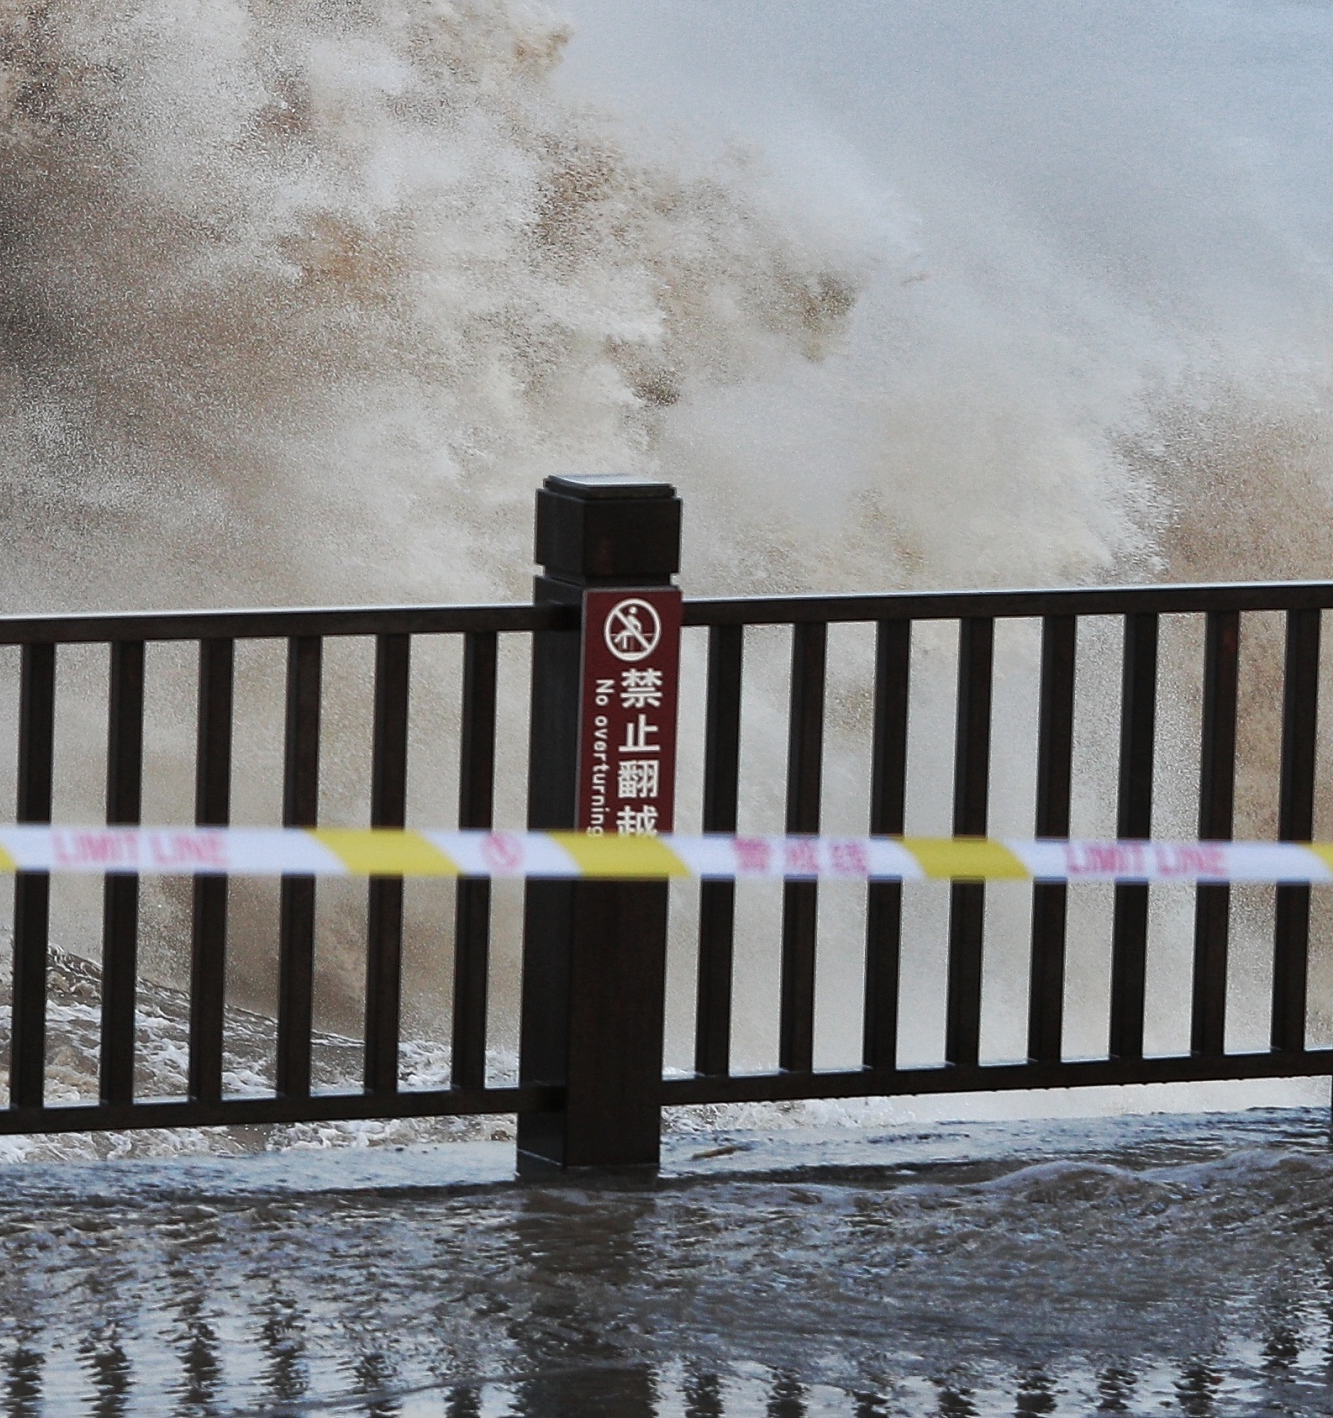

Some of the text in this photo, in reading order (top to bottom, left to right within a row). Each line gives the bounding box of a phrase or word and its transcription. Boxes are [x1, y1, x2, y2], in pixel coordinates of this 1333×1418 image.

[586, 679, 615, 837] No overturning
[616, 668, 663, 835] 禁止翻越
